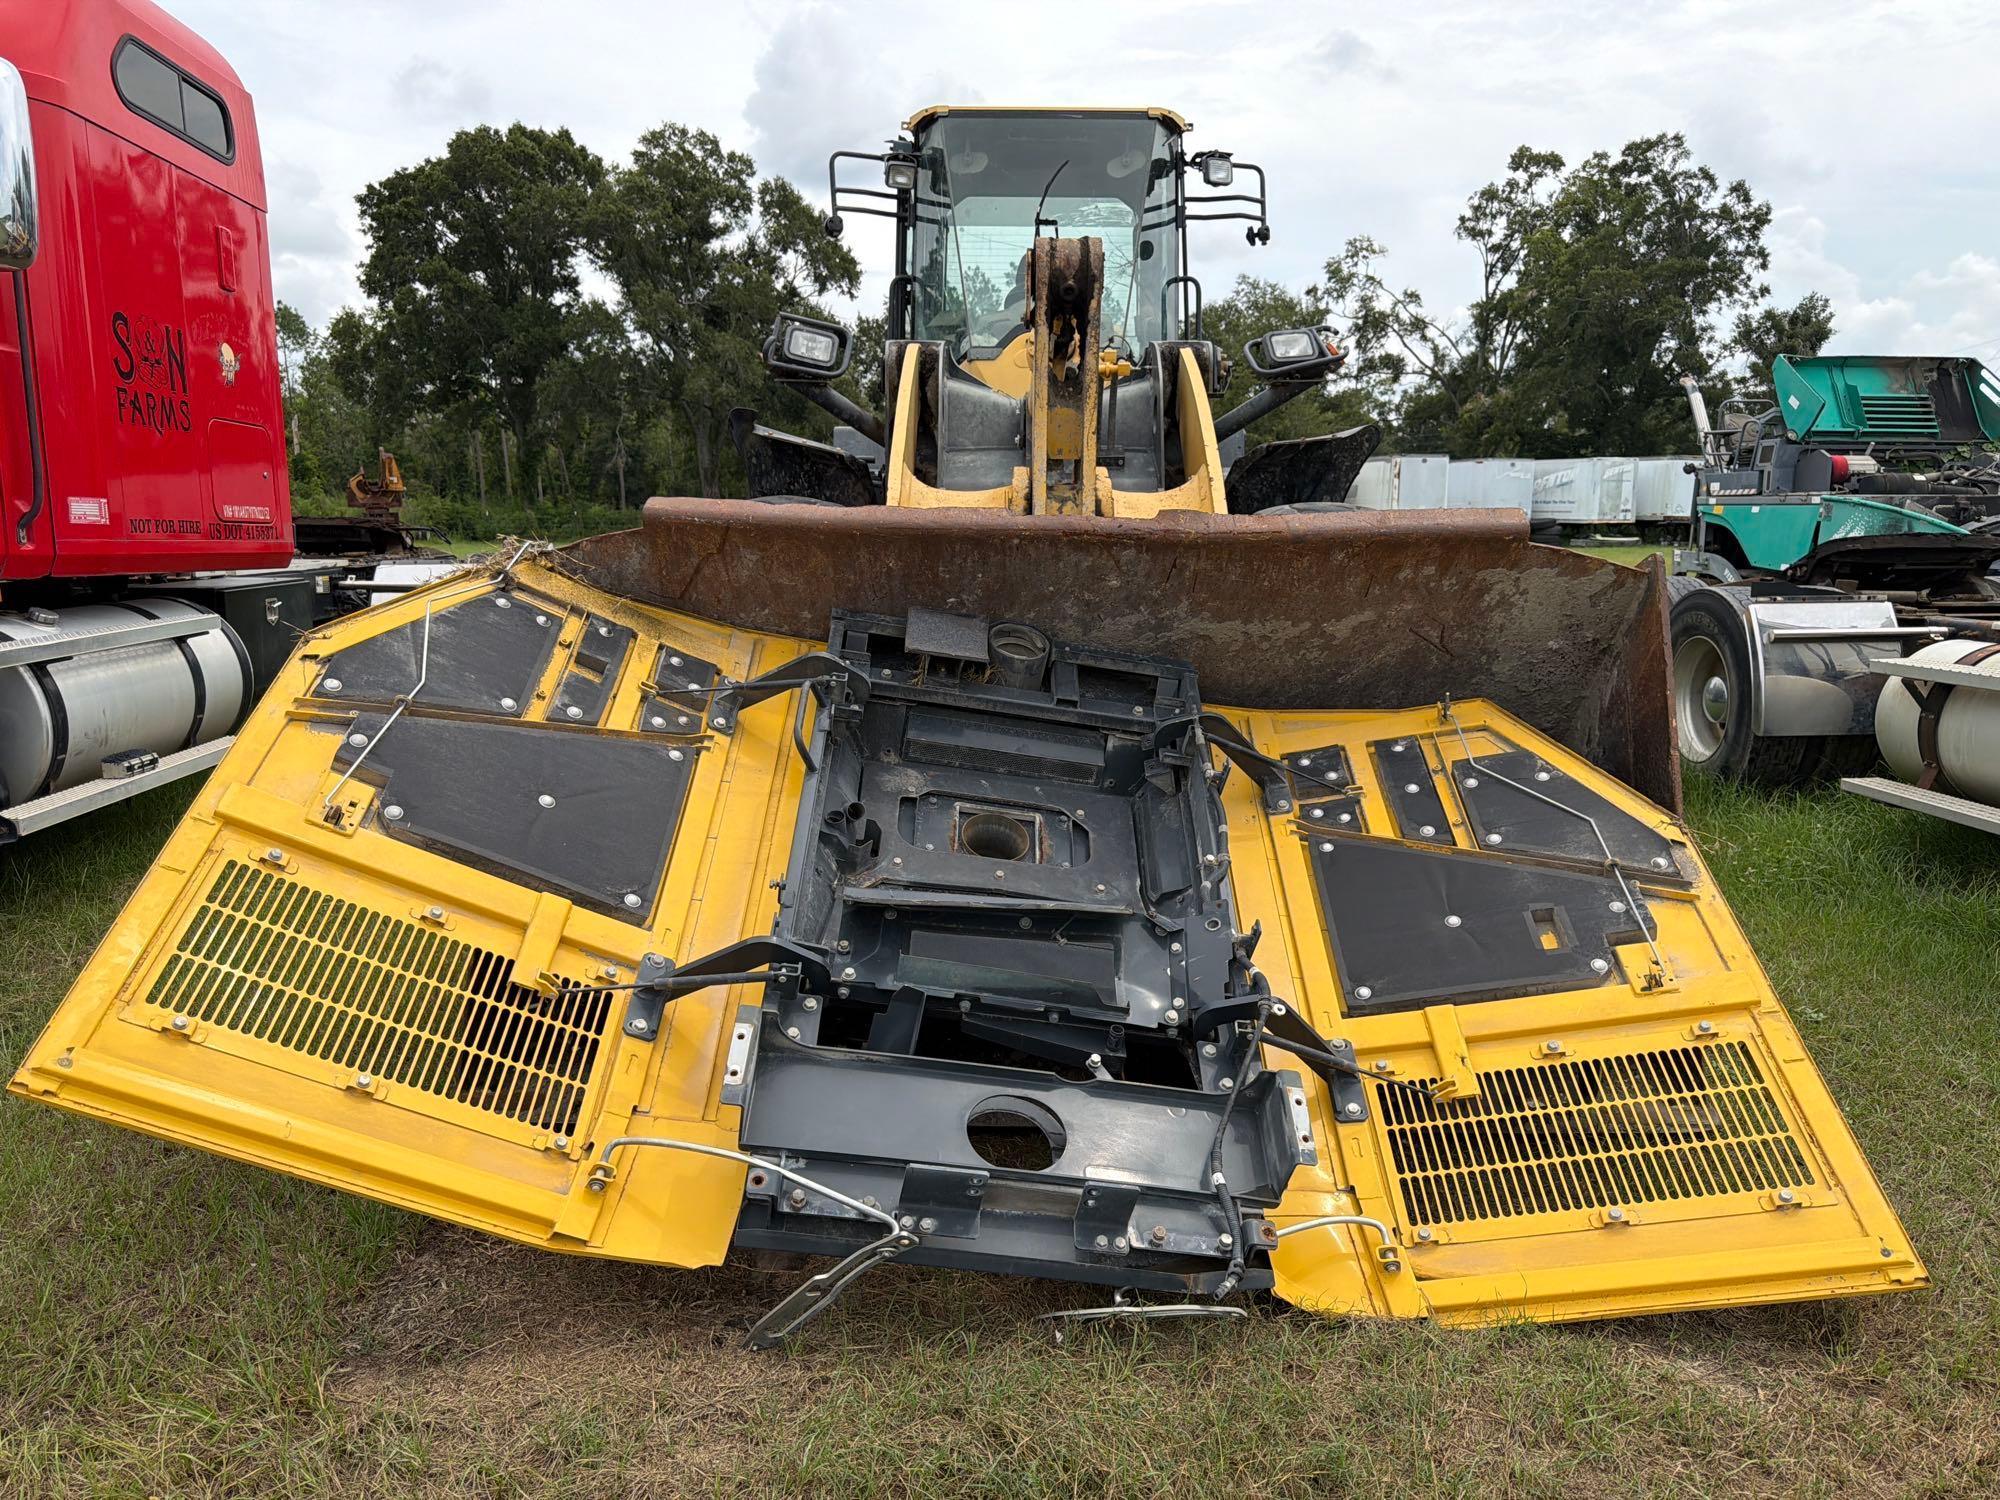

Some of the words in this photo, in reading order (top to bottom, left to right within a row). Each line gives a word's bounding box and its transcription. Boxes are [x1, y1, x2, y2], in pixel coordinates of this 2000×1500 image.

[112, 311, 135, 384] S
[164, 325, 188, 396] N
[116, 387, 191, 437] FARMS
[129, 519, 151, 534] NOT
[155, 520, 176, 534] FOR
[178, 520, 201, 534] HIRE
[209, 523, 222, 540] US
[224, 524, 243, 540] DOT
